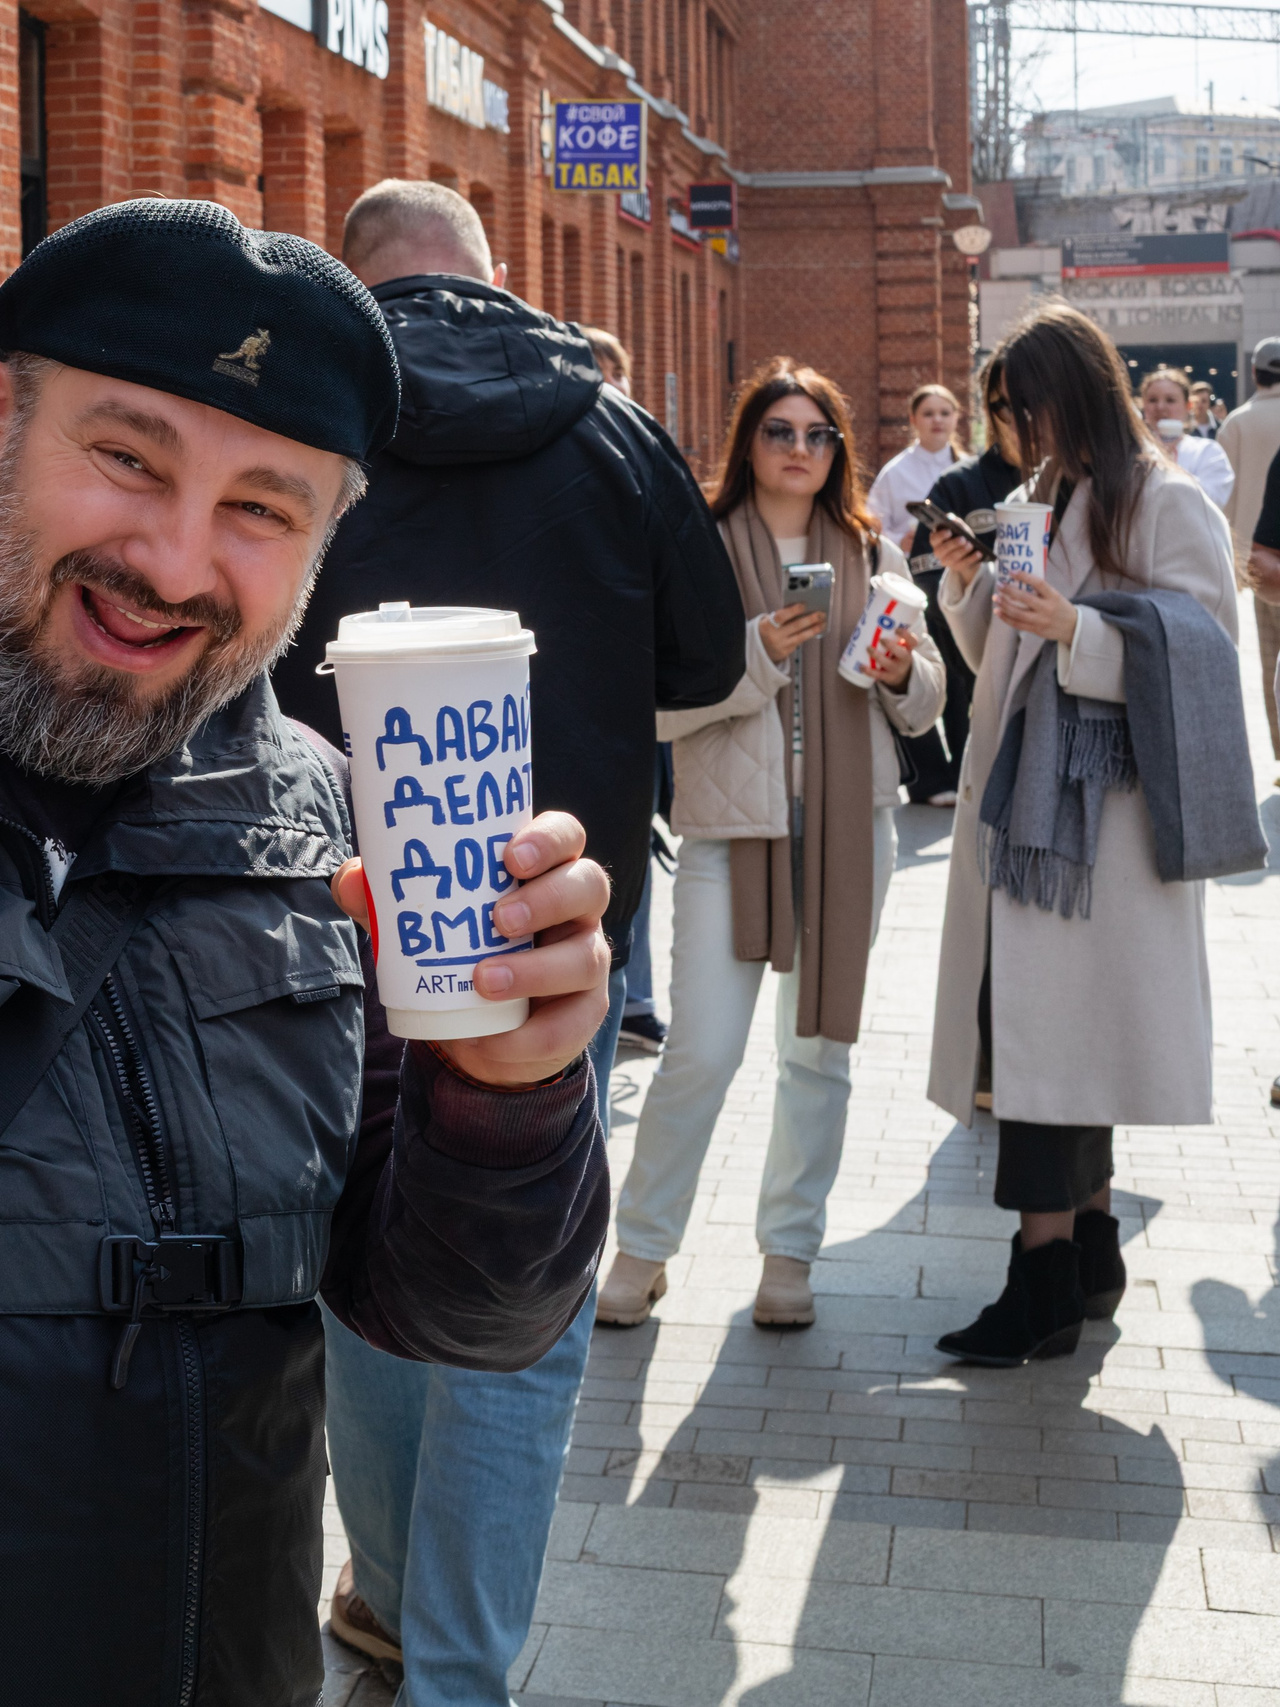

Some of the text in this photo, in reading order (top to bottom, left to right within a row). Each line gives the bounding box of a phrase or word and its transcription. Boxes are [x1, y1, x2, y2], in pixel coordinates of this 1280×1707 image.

[327, 0, 389, 80] PIMS
[558, 124, 639, 150] КОФЕ
[557, 163, 638, 187] ТАБАК
[384, 762, 533, 829] ДЕЛАТ
[390, 833, 516, 903] ДОБ
[397, 901, 510, 957] ВМЕ
[415, 974, 458, 994] ART
